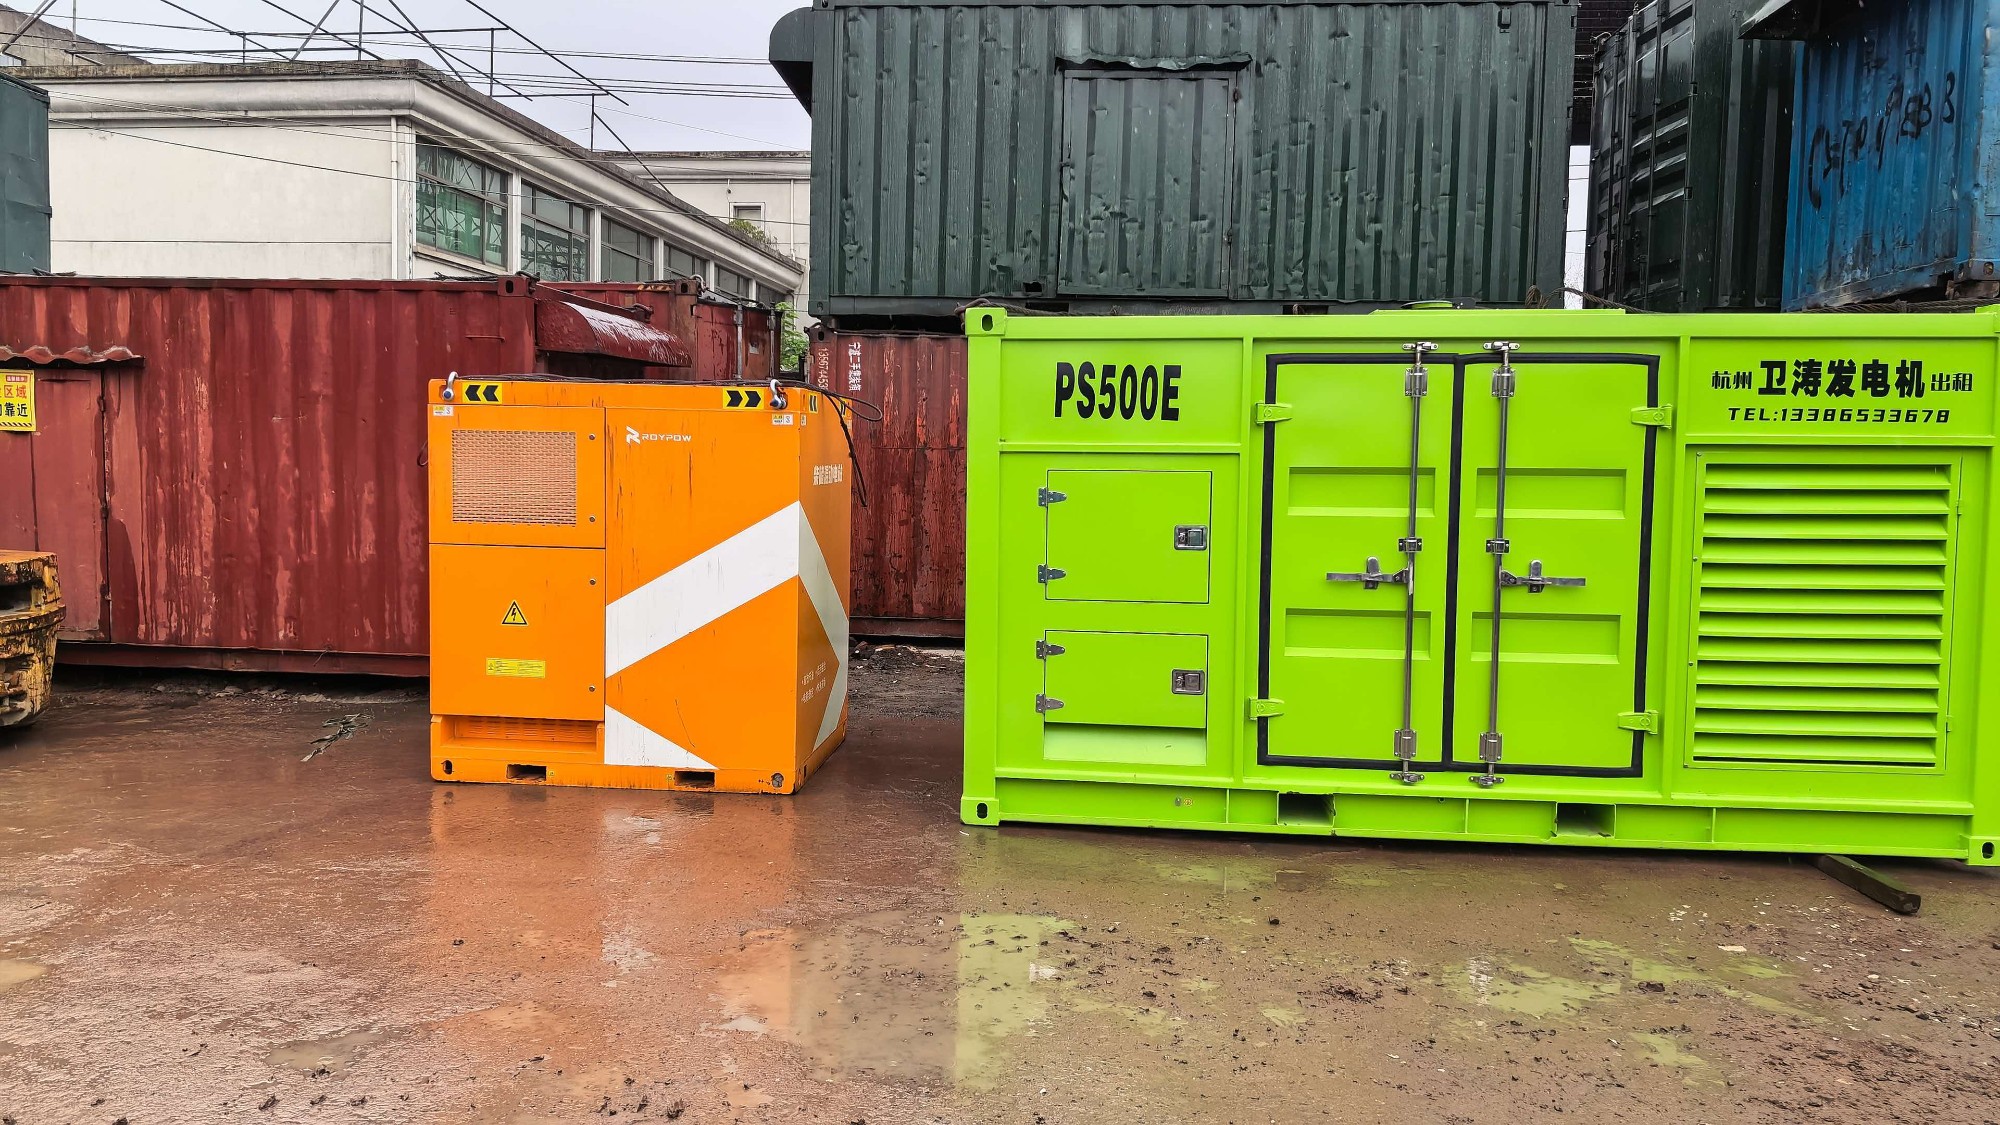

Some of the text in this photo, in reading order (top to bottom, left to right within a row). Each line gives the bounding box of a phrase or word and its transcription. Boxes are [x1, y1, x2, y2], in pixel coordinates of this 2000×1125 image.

[1712, 359, 1972, 398] 杭州卫涛发电机出租
[0, 385, 27, 399] 区域
[1055, 362, 1181, 421] PS500E
[0, 402, 28, 417] 靠近
[1729, 408, 1949, 422] TEL:13386533678
[642, 433, 692, 442] ROYPOW
